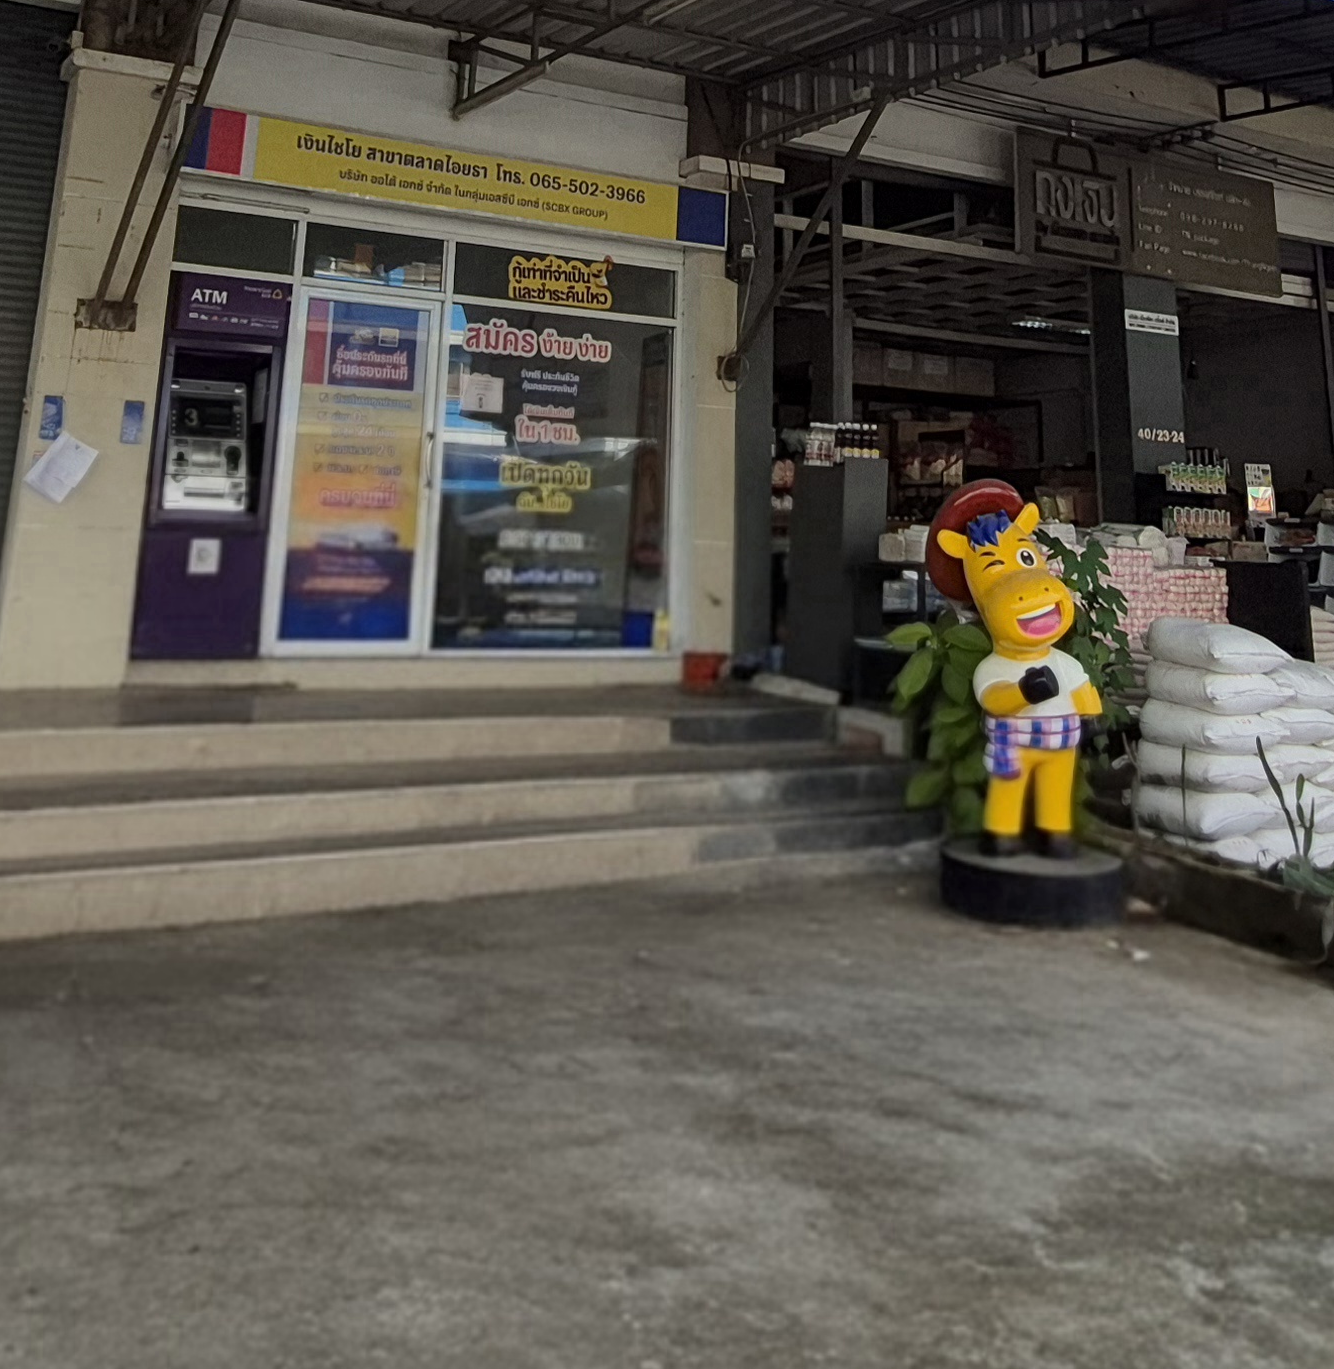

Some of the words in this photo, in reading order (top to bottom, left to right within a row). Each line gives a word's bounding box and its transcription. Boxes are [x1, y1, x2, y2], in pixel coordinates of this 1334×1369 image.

[297, 132, 362, 159] เงินไชโย
[366, 144, 488, 179] สาขาตลาดไอยรา
[496, 163, 526, 185] โทร.
[529, 171, 646, 205] 065-502-3966
[339, 168, 368, 183] บริษัท
[426, 180, 452, 196] จำกัด
[542, 199, 570, 215] (SCBX
[572, 205, 608, 222] GROUP)
[191, 288, 228, 305] ATM
[465, 321, 536, 355] สมัคร
[578, 337, 610, 360] ง่าย
